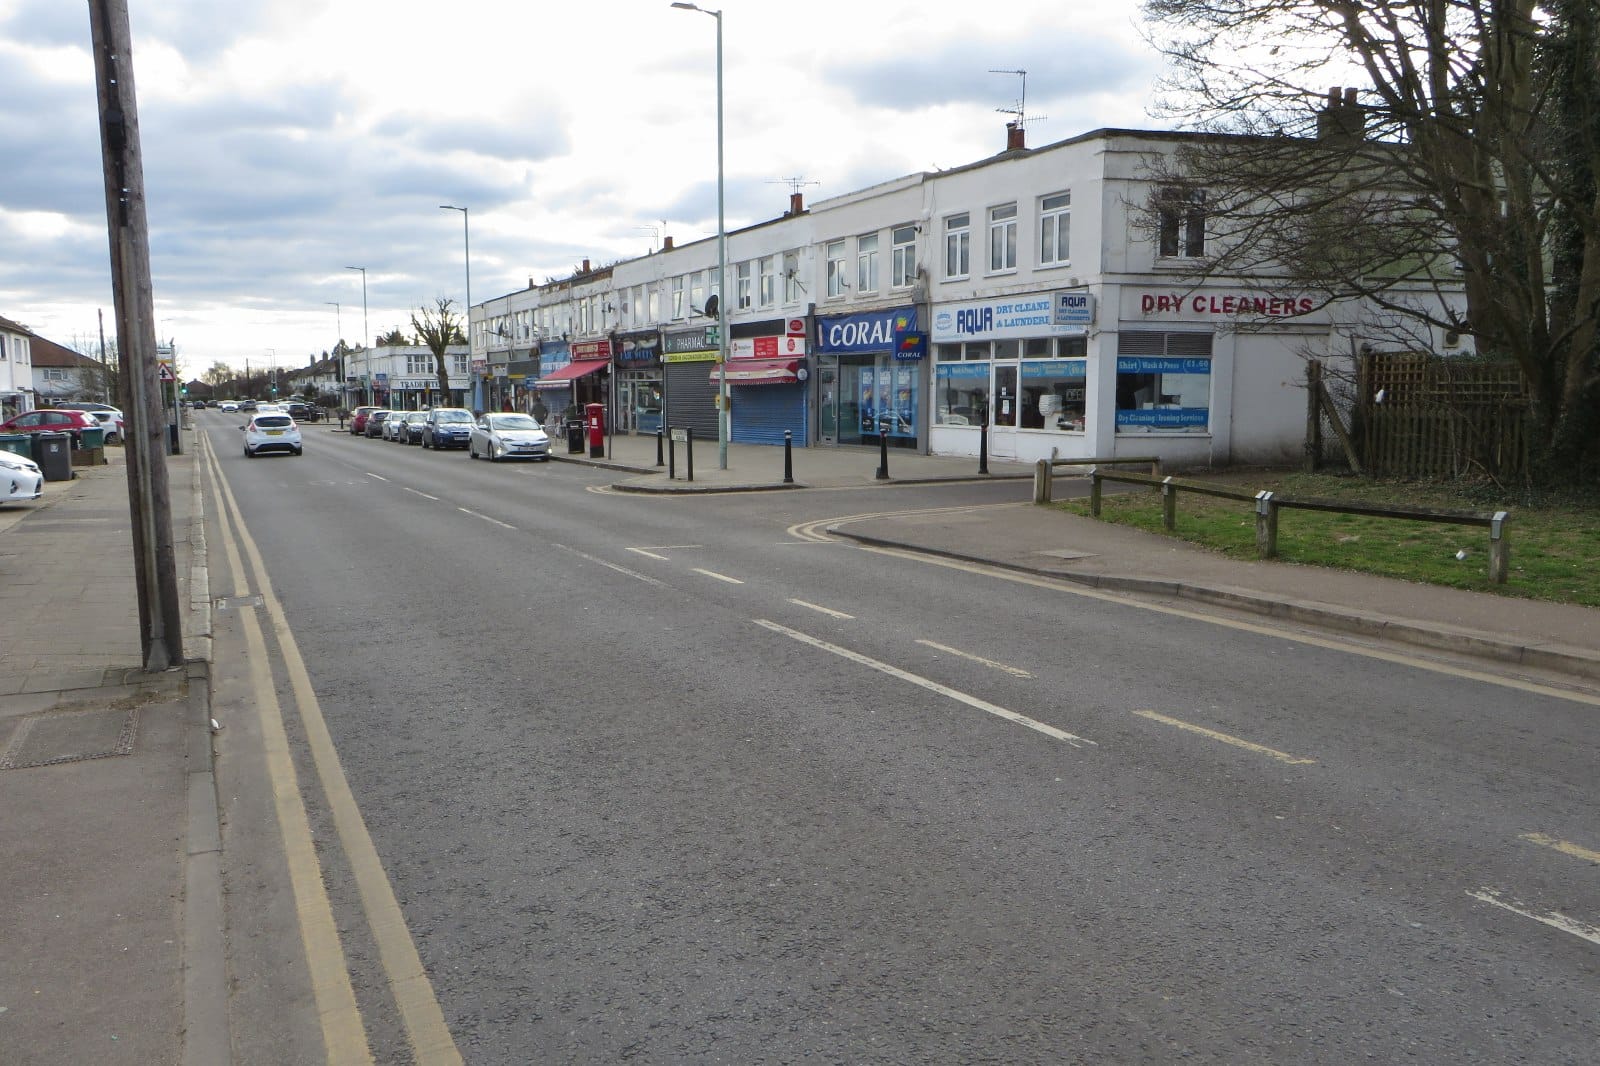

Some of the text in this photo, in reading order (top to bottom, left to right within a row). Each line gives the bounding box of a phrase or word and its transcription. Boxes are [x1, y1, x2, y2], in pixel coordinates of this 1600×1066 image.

[1062, 296, 1086, 308] AQUA
[1142, 294, 1313, 315] DRY CLEANERS
[996, 305, 1013, 314] DRY
[957, 307, 992, 335] AQUA
[829, 319, 893, 346] CORAL
[677, 335, 707, 349] PHARMAC
[1119, 361, 1137, 369] Shirt
